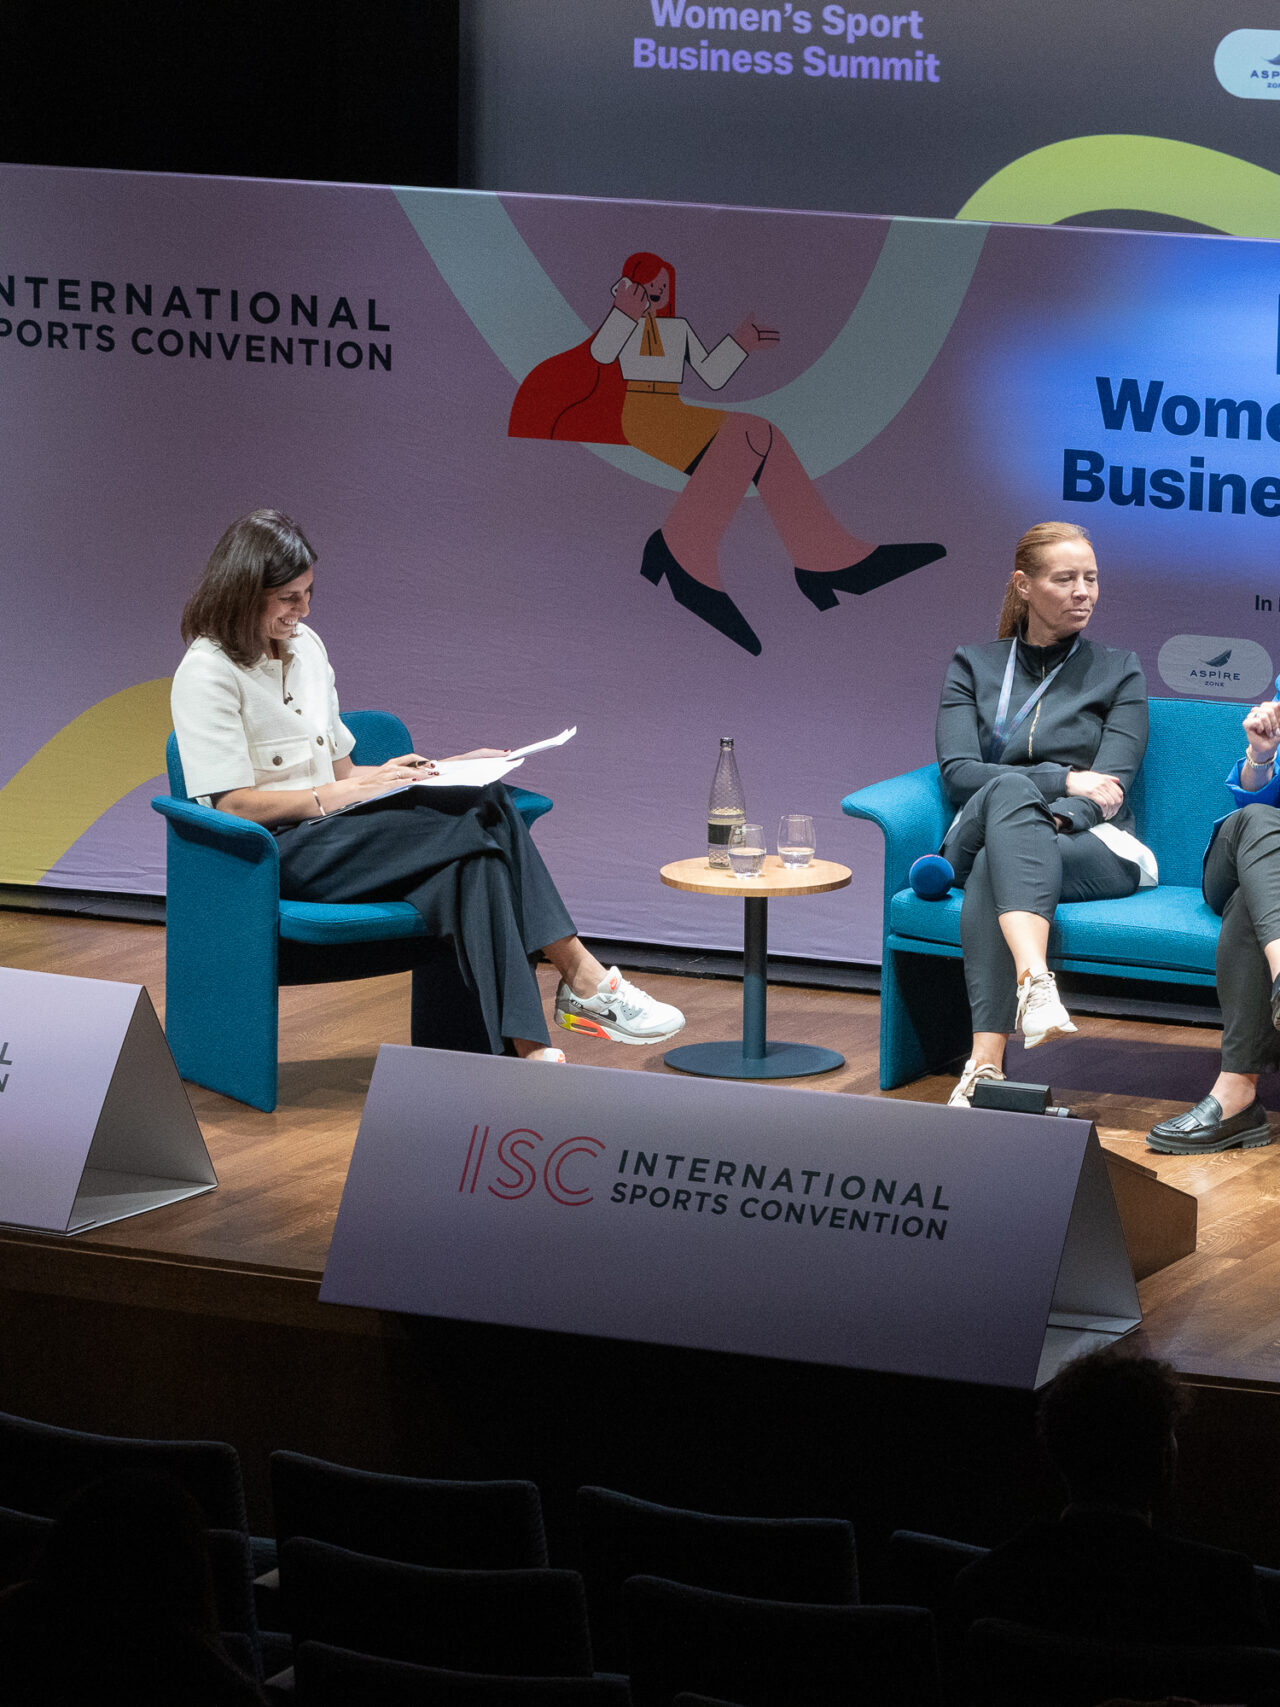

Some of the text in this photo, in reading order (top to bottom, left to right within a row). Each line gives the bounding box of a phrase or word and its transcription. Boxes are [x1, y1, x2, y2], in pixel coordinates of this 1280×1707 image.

[650, 0, 924, 43] Women’s Sport
[633, 37, 941, 83] Business Summit
[131, 327, 393, 371] CONVENTION
[1254, 594, 1272, 612] In
[1189, 669, 1241, 682] ASPIRE
[459, 1124, 606, 1207] ISC
[618, 1149, 951, 1211] INTERNATIONAL
[610, 1182, 949, 1241] SPORTS CONVENTION
